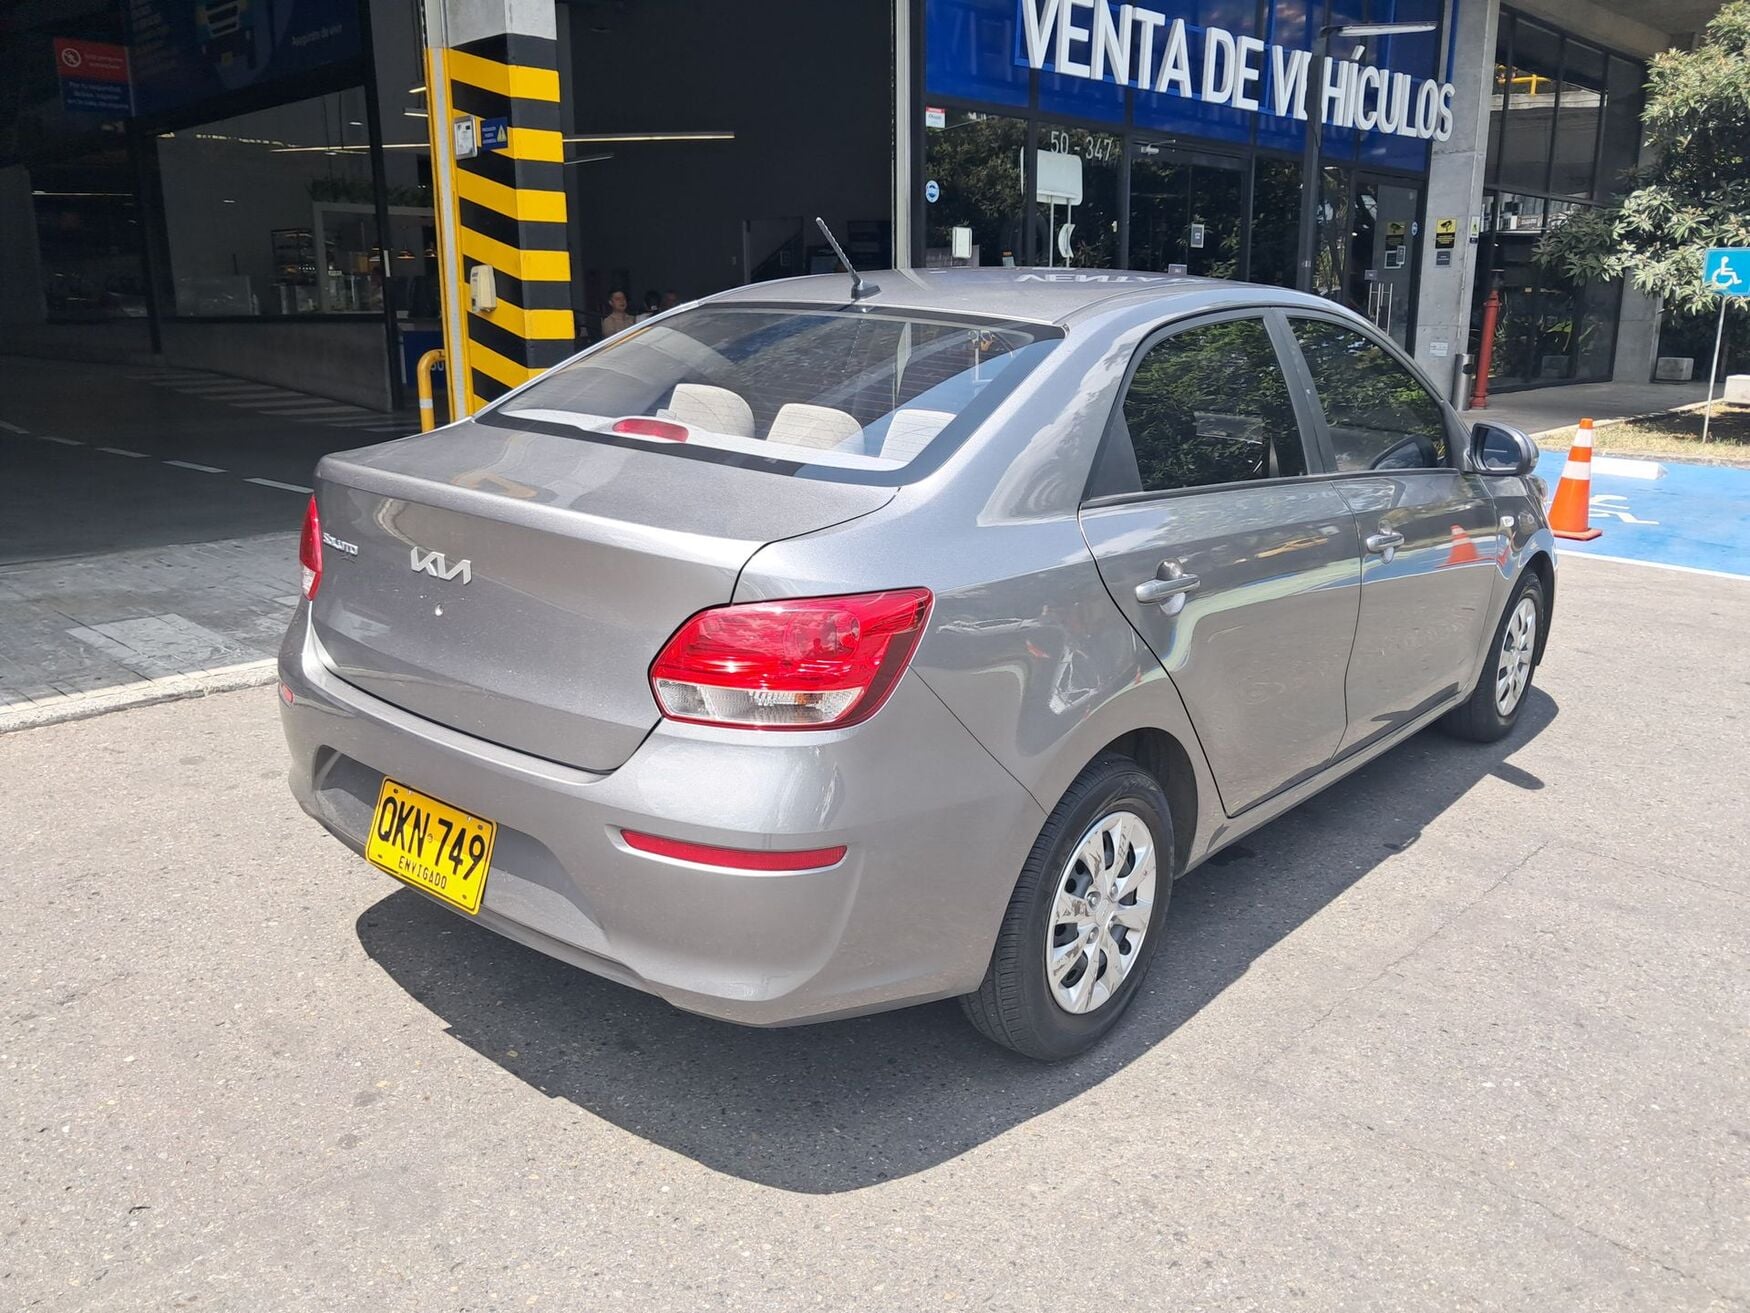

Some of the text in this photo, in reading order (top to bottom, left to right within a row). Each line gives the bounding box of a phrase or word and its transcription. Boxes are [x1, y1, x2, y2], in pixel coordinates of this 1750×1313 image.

[1022, 0, 1193, 98] VENTA
[1202, 27, 1264, 111] DE
[1050, 130, 1069, 154] 50
[1085, 136, 1113, 161] 347
[410, 546, 472, 585] KIA
[435, 818, 486, 881] 749
[398, 856, 448, 890] ENVIGADO
